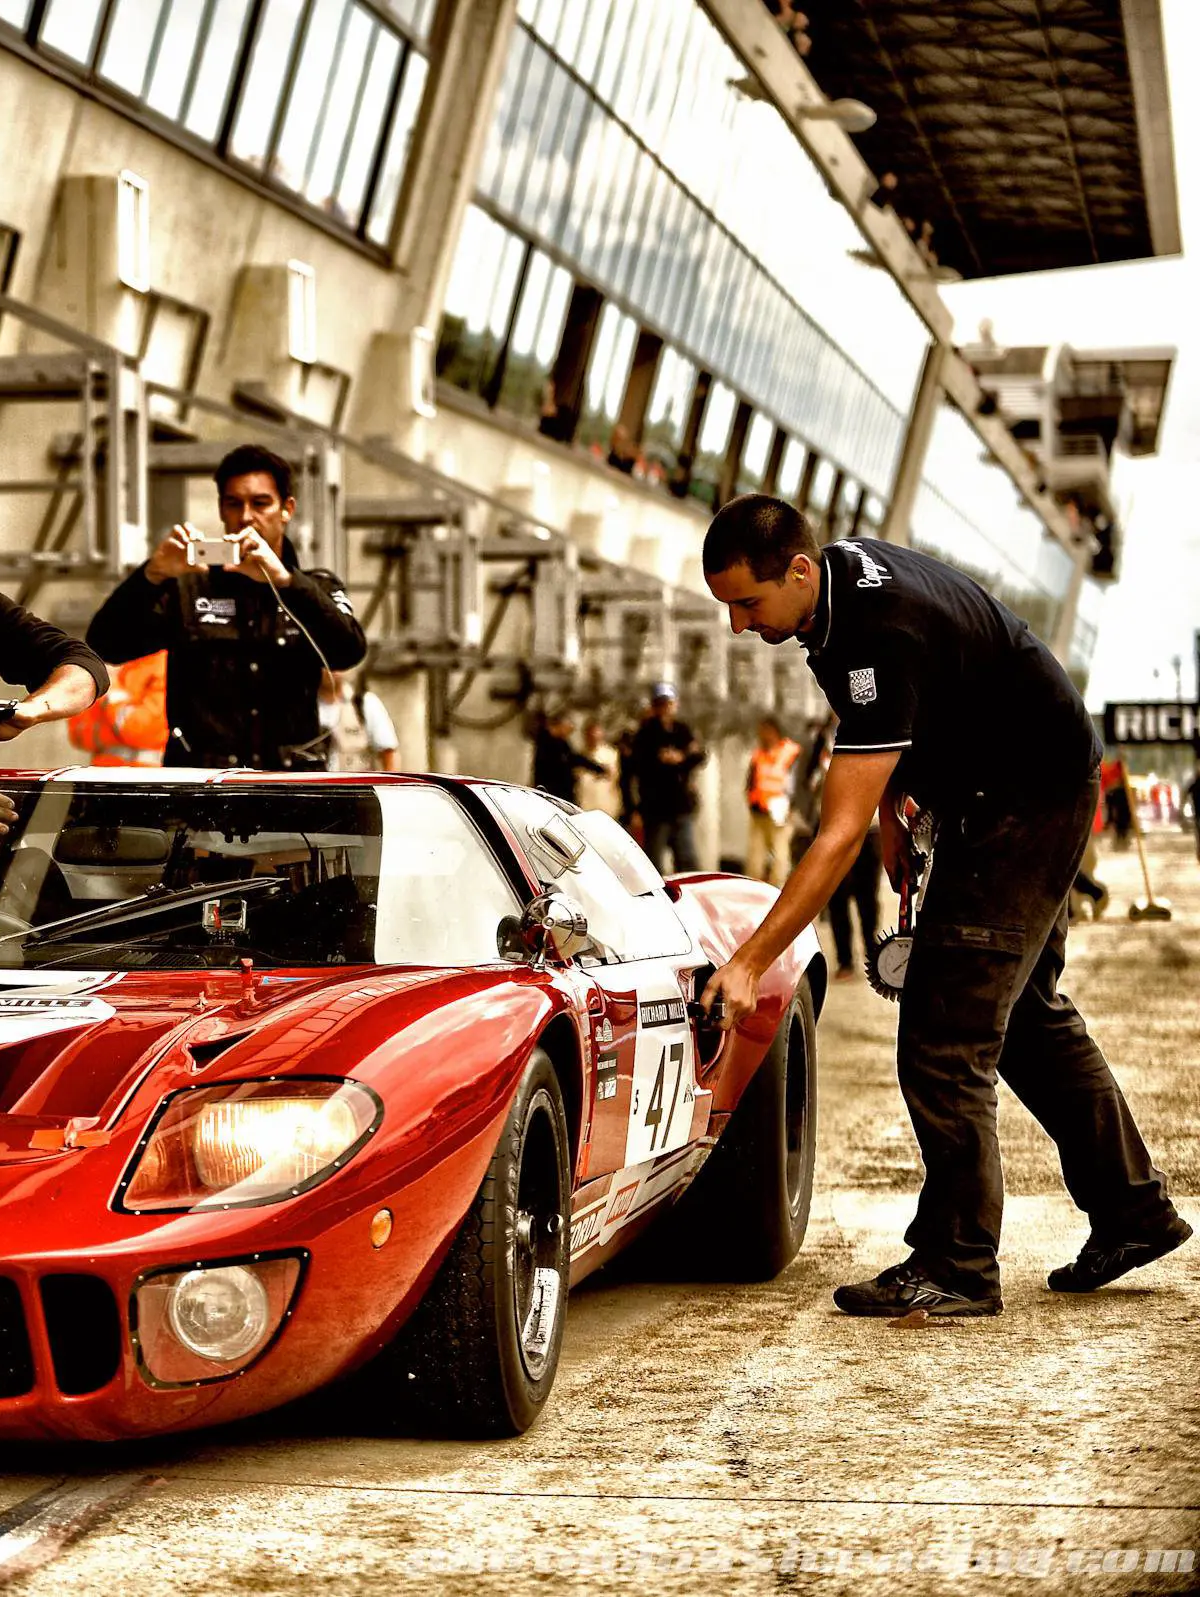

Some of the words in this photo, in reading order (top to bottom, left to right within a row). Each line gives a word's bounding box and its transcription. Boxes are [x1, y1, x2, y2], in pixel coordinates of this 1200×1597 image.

[1114, 704, 1200, 742] RICH
[640, 1003, 668, 1023] RICHARD
[668, 1001, 685, 1020] MILLE
[644, 1042, 684, 1151] 47
